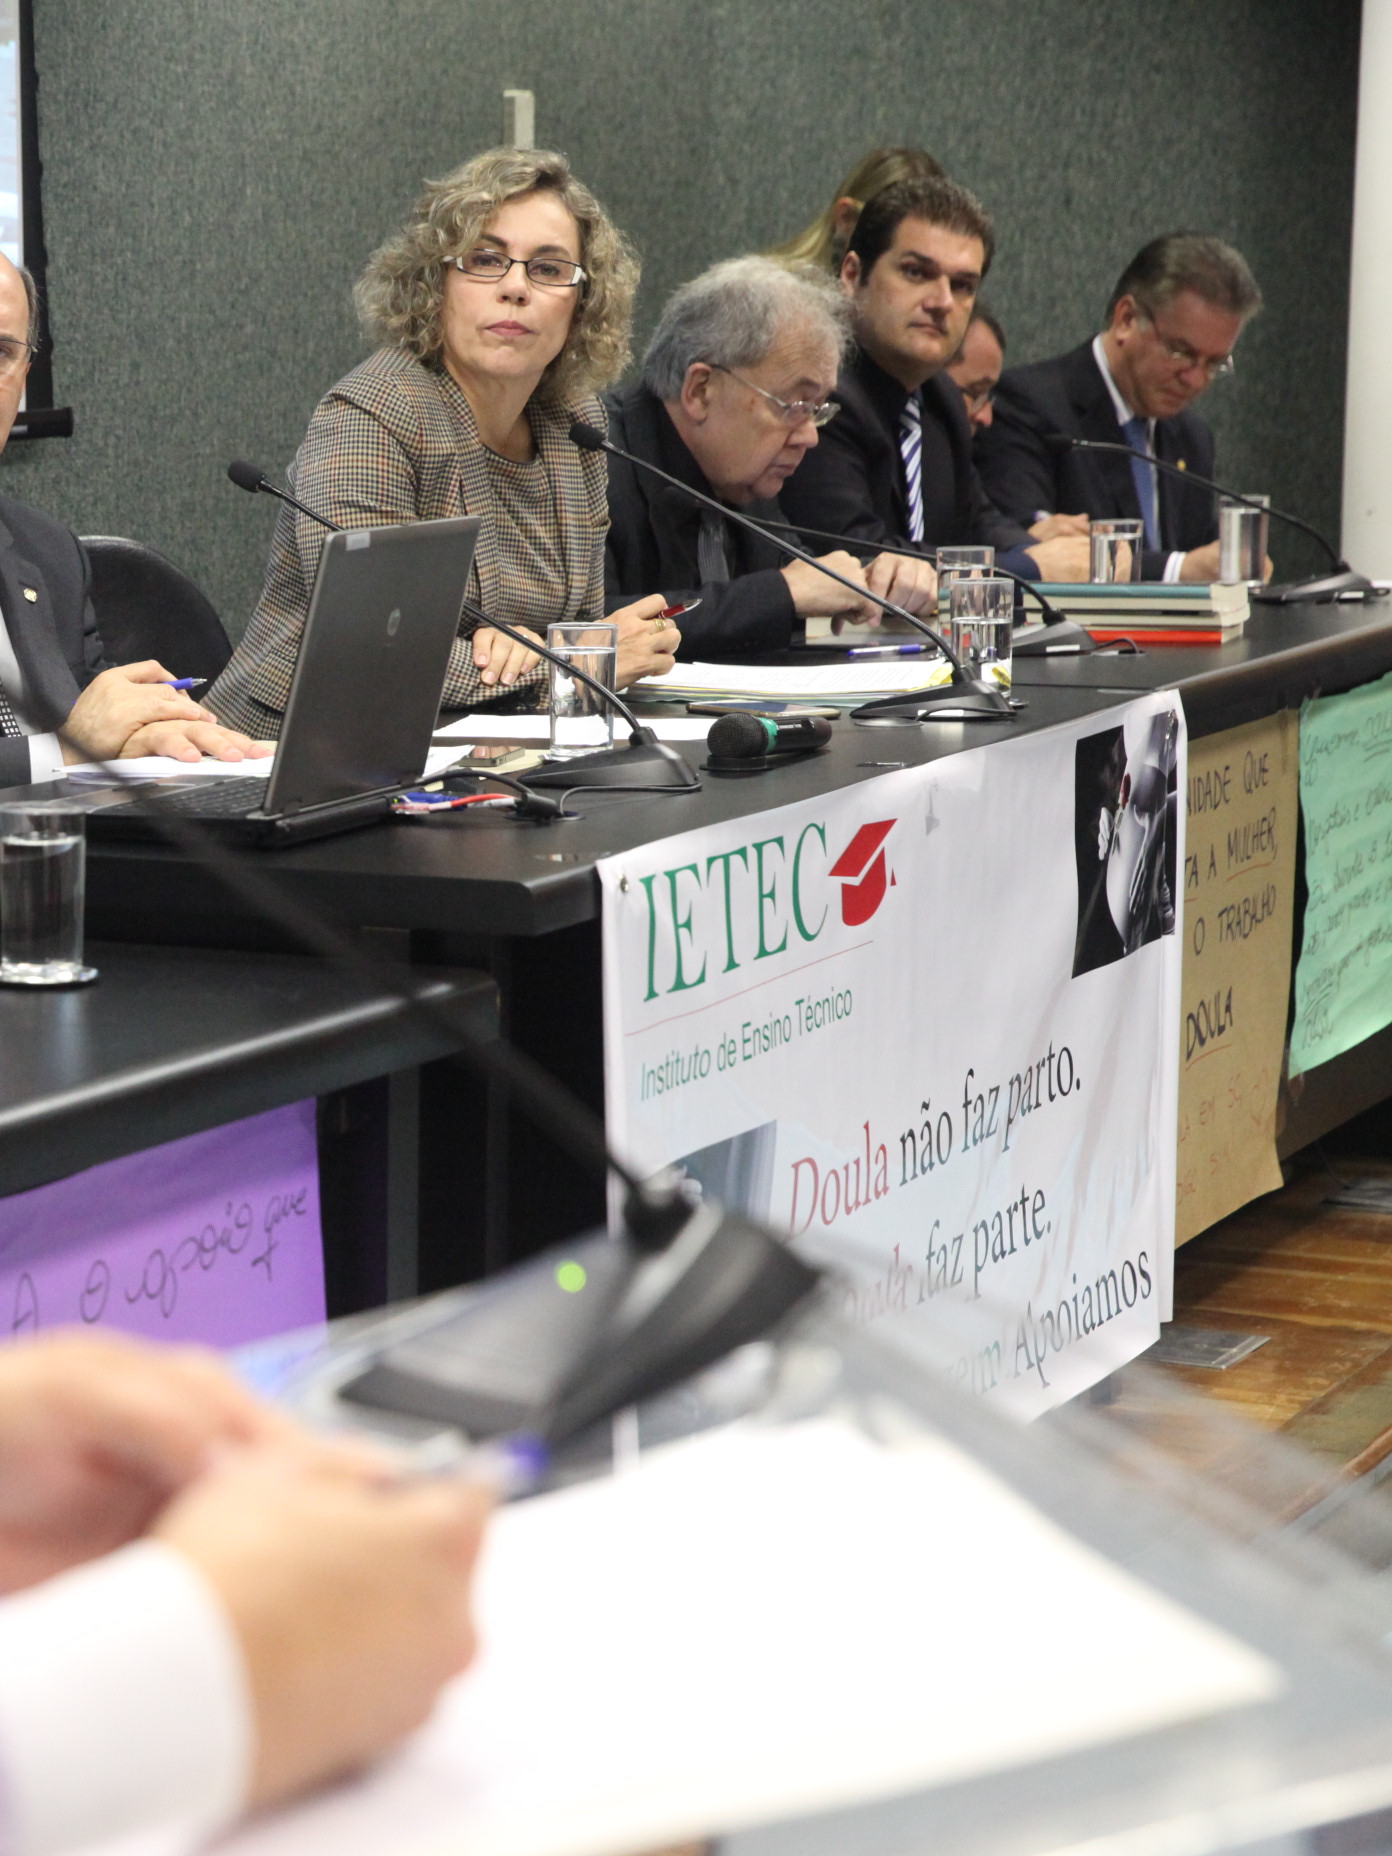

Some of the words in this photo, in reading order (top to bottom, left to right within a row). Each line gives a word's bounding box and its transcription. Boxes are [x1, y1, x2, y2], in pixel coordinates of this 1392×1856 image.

[1187, 765, 1231, 817] NIDADE
[1243, 750, 1269, 794] QUE
[639, 821, 829, 1003] IETEC
[1184, 853, 1199, 888] TA
[1207, 843, 1217, 881] A
[1194, 916, 1206, 956] O
[1218, 882, 1277, 943] TRABALHO
[640, 1043, 711, 1102] Instituto
[717, 1031, 737, 1072] de
[742, 1012, 792, 1062] Ensino
[795, 986, 853, 1036] Técnico
[1185, 985, 1233, 1061] DOULA
[789, 1120, 890, 1238] Doula
[898, 1098, 953, 1187] não
[961, 1068, 1001, 1153] faz
[1001, 1040, 1081, 1153] parto.
[916, 1219, 964, 1305] faz
[964, 1183, 1051, 1302] parte.
[1013, 1251, 1152, 1389] Apoiamos
